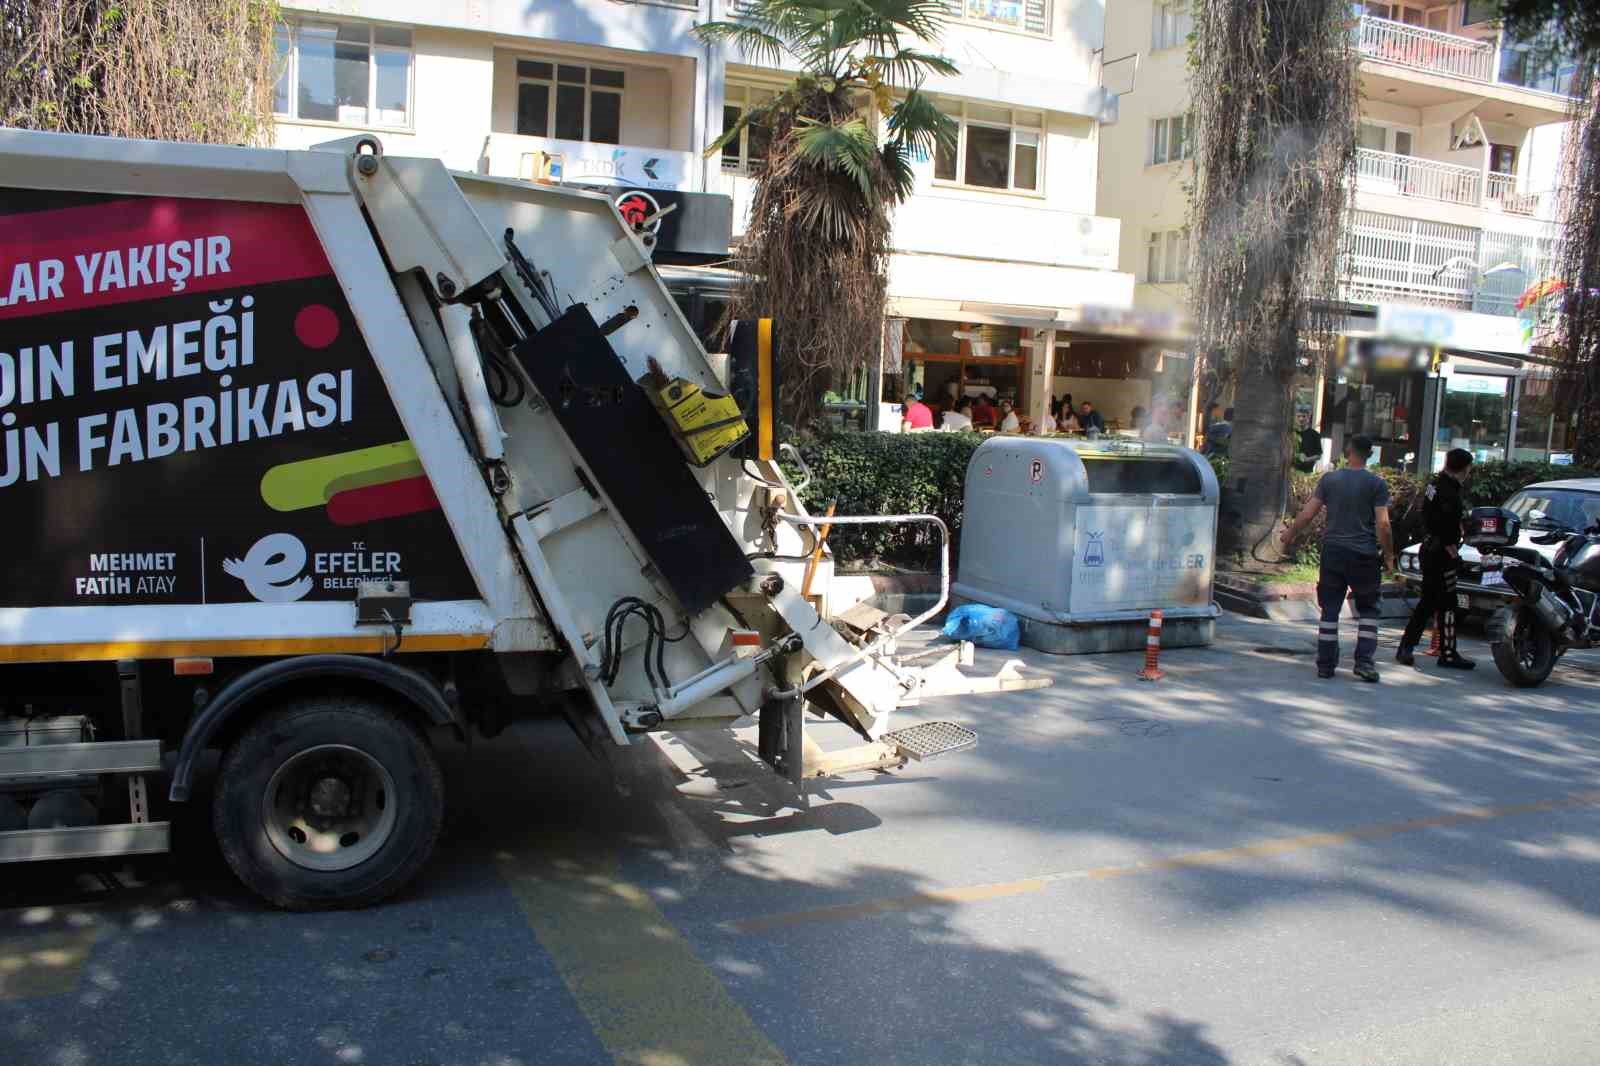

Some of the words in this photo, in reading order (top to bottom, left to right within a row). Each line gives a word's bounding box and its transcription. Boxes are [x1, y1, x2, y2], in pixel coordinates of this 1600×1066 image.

[0, 258, 65, 307] AR
[75, 235, 232, 293] YAKIŞIR
[93, 296, 254, 392] EMEĞİ
[78, 369, 353, 472] FABRİKASI
[75, 572, 131, 595] FATİH
[136, 576, 176, 594] ATAY
[90, 553, 176, 571] MEHMET
[314, 551, 401, 573] EFELER
